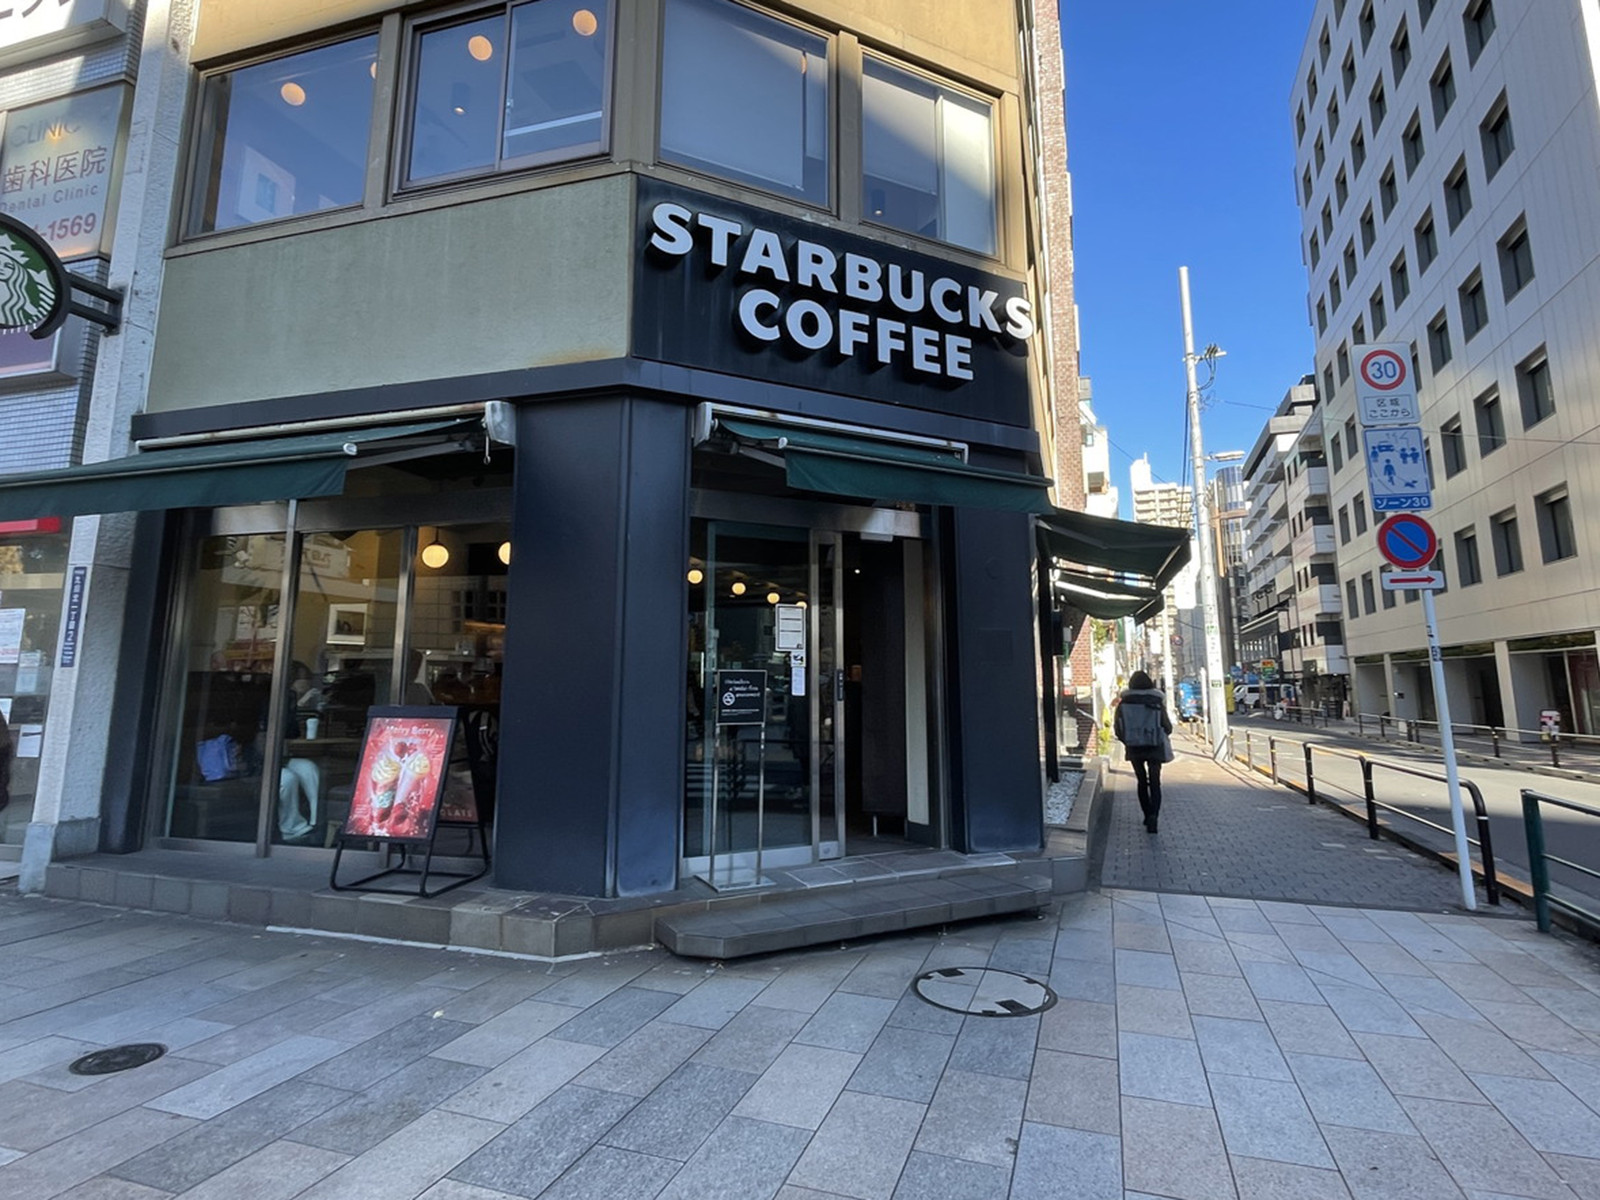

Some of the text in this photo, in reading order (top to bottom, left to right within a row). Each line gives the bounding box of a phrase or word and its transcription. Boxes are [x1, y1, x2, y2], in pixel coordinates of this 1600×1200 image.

[2, 146, 108, 194] 歯科医院
[53, 184, 99, 204] Clinic
[650, 202, 1034, 340] STARBUCKS
[738, 288, 975, 382] COFFEE
[1370, 360, 1397, 380] 30
[1368, 407, 1411, 419] ここから
[1375, 496, 1430, 509] ゾーン30
